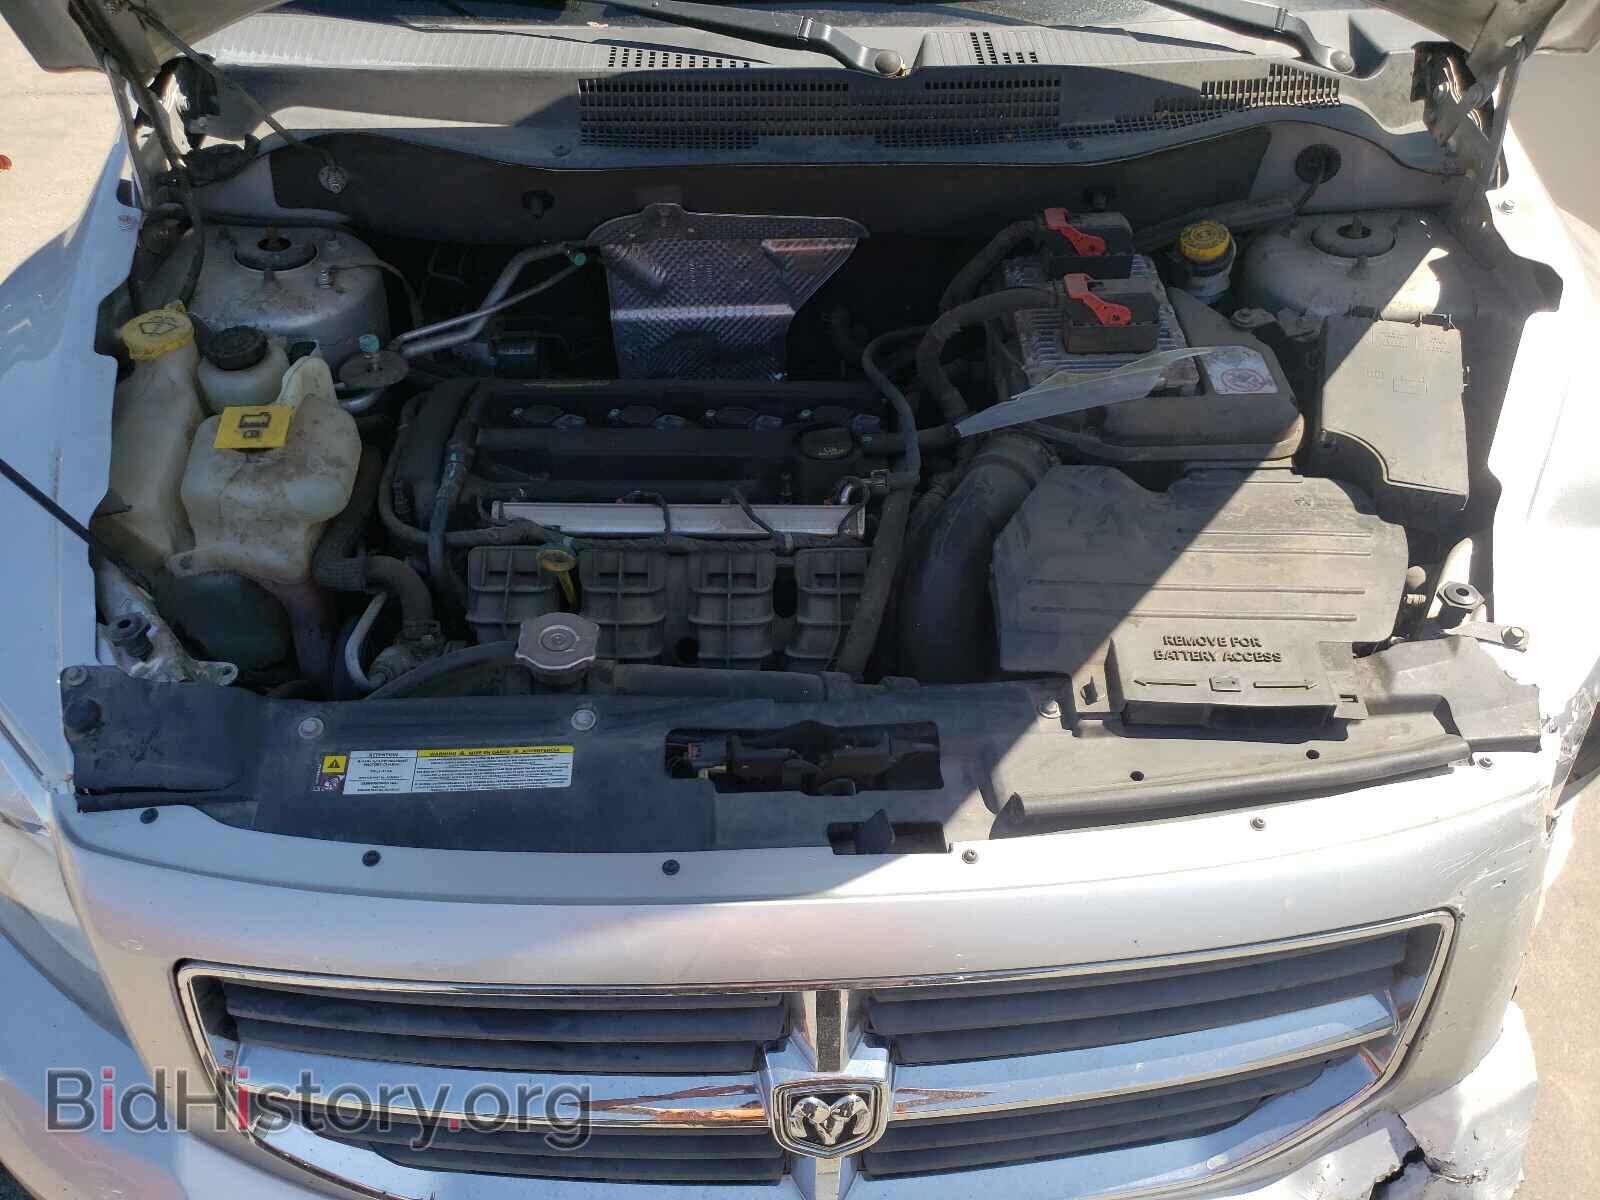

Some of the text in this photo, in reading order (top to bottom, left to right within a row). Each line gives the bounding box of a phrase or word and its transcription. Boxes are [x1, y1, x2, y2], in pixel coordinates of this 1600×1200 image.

[1163, 635, 1262, 648] REMOVE FOR
[1154, 650, 1282, 662] BATTERY ACCESS
